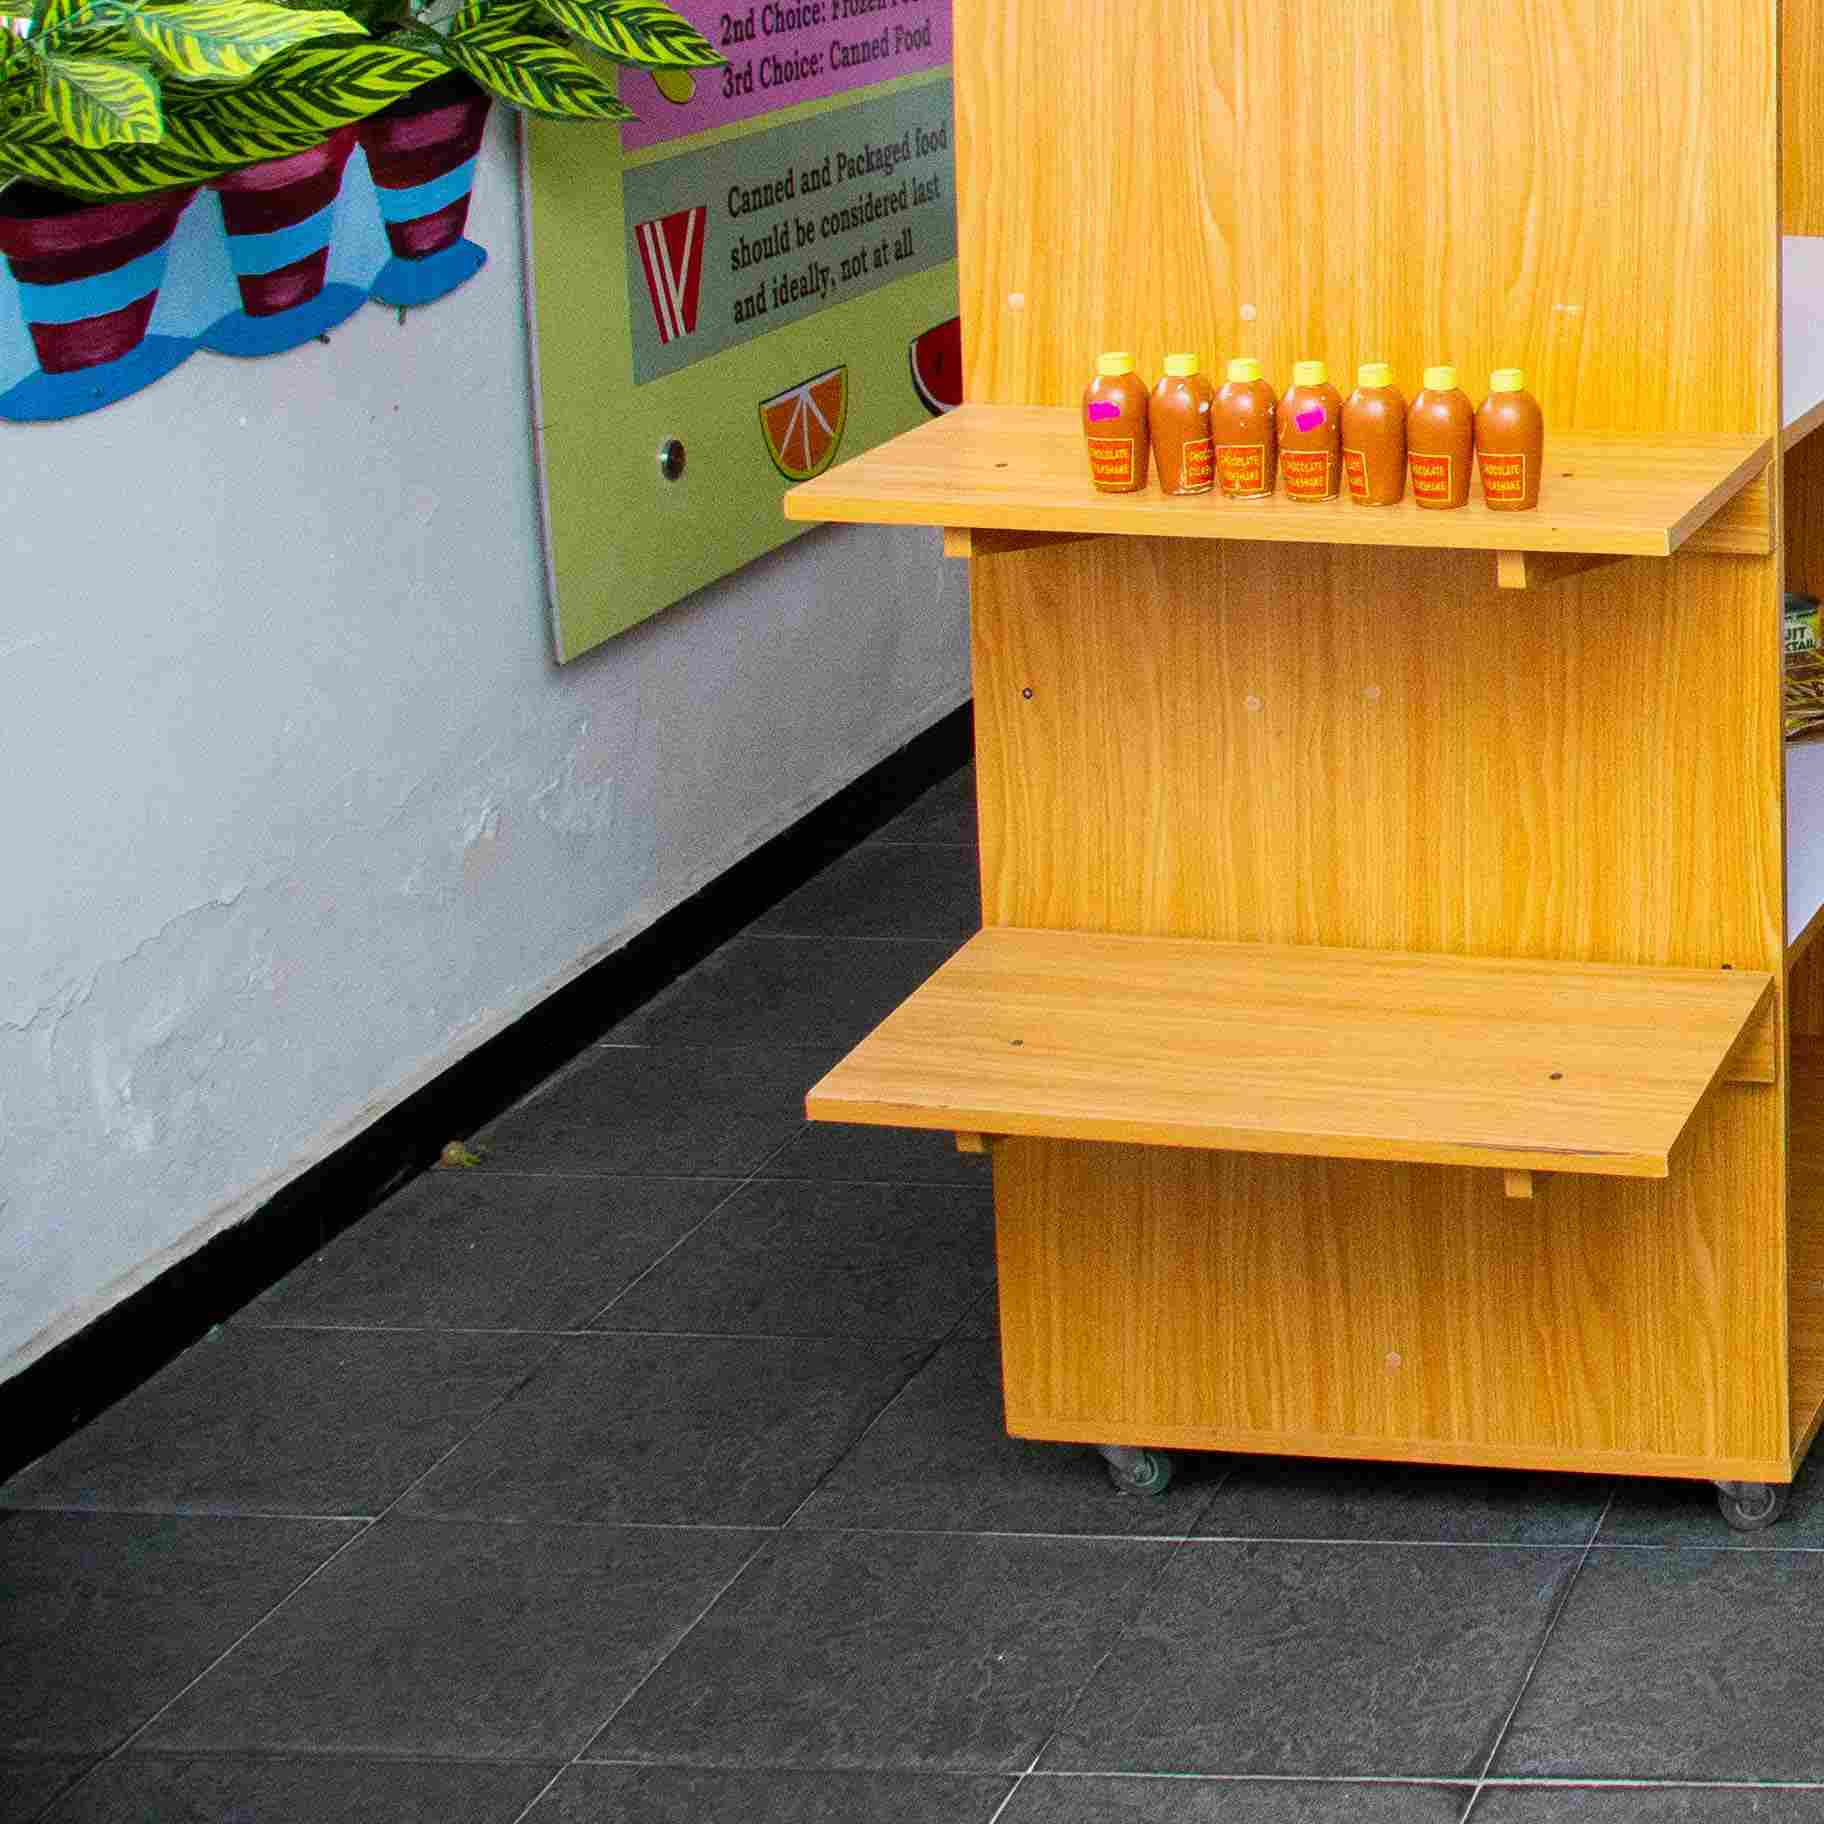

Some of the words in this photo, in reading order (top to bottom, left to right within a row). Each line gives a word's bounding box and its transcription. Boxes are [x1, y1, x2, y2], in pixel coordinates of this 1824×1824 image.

[720, 8, 756, 46] 2nd
[722, 60, 753, 99] 3rd
[759, 50, 824, 88] Choice:
[829, 27, 890, 71] Canned
[894, 18, 932, 55] Food
[727, 167, 795, 218] Canned
[800, 156, 832, 195] and
[835, 132, 911, 178] Packaged
[914, 120, 948, 158] food
[730, 220, 790, 271] should
[795, 216, 816, 248] be
[821, 179, 908, 239] considered
[911, 173, 941, 207] last
[733, 281, 767, 325] and
[771, 260, 837, 310] ideally,
[840, 246, 869, 282] not
[872, 238, 890, 269] at
[893, 227, 915, 261] all
